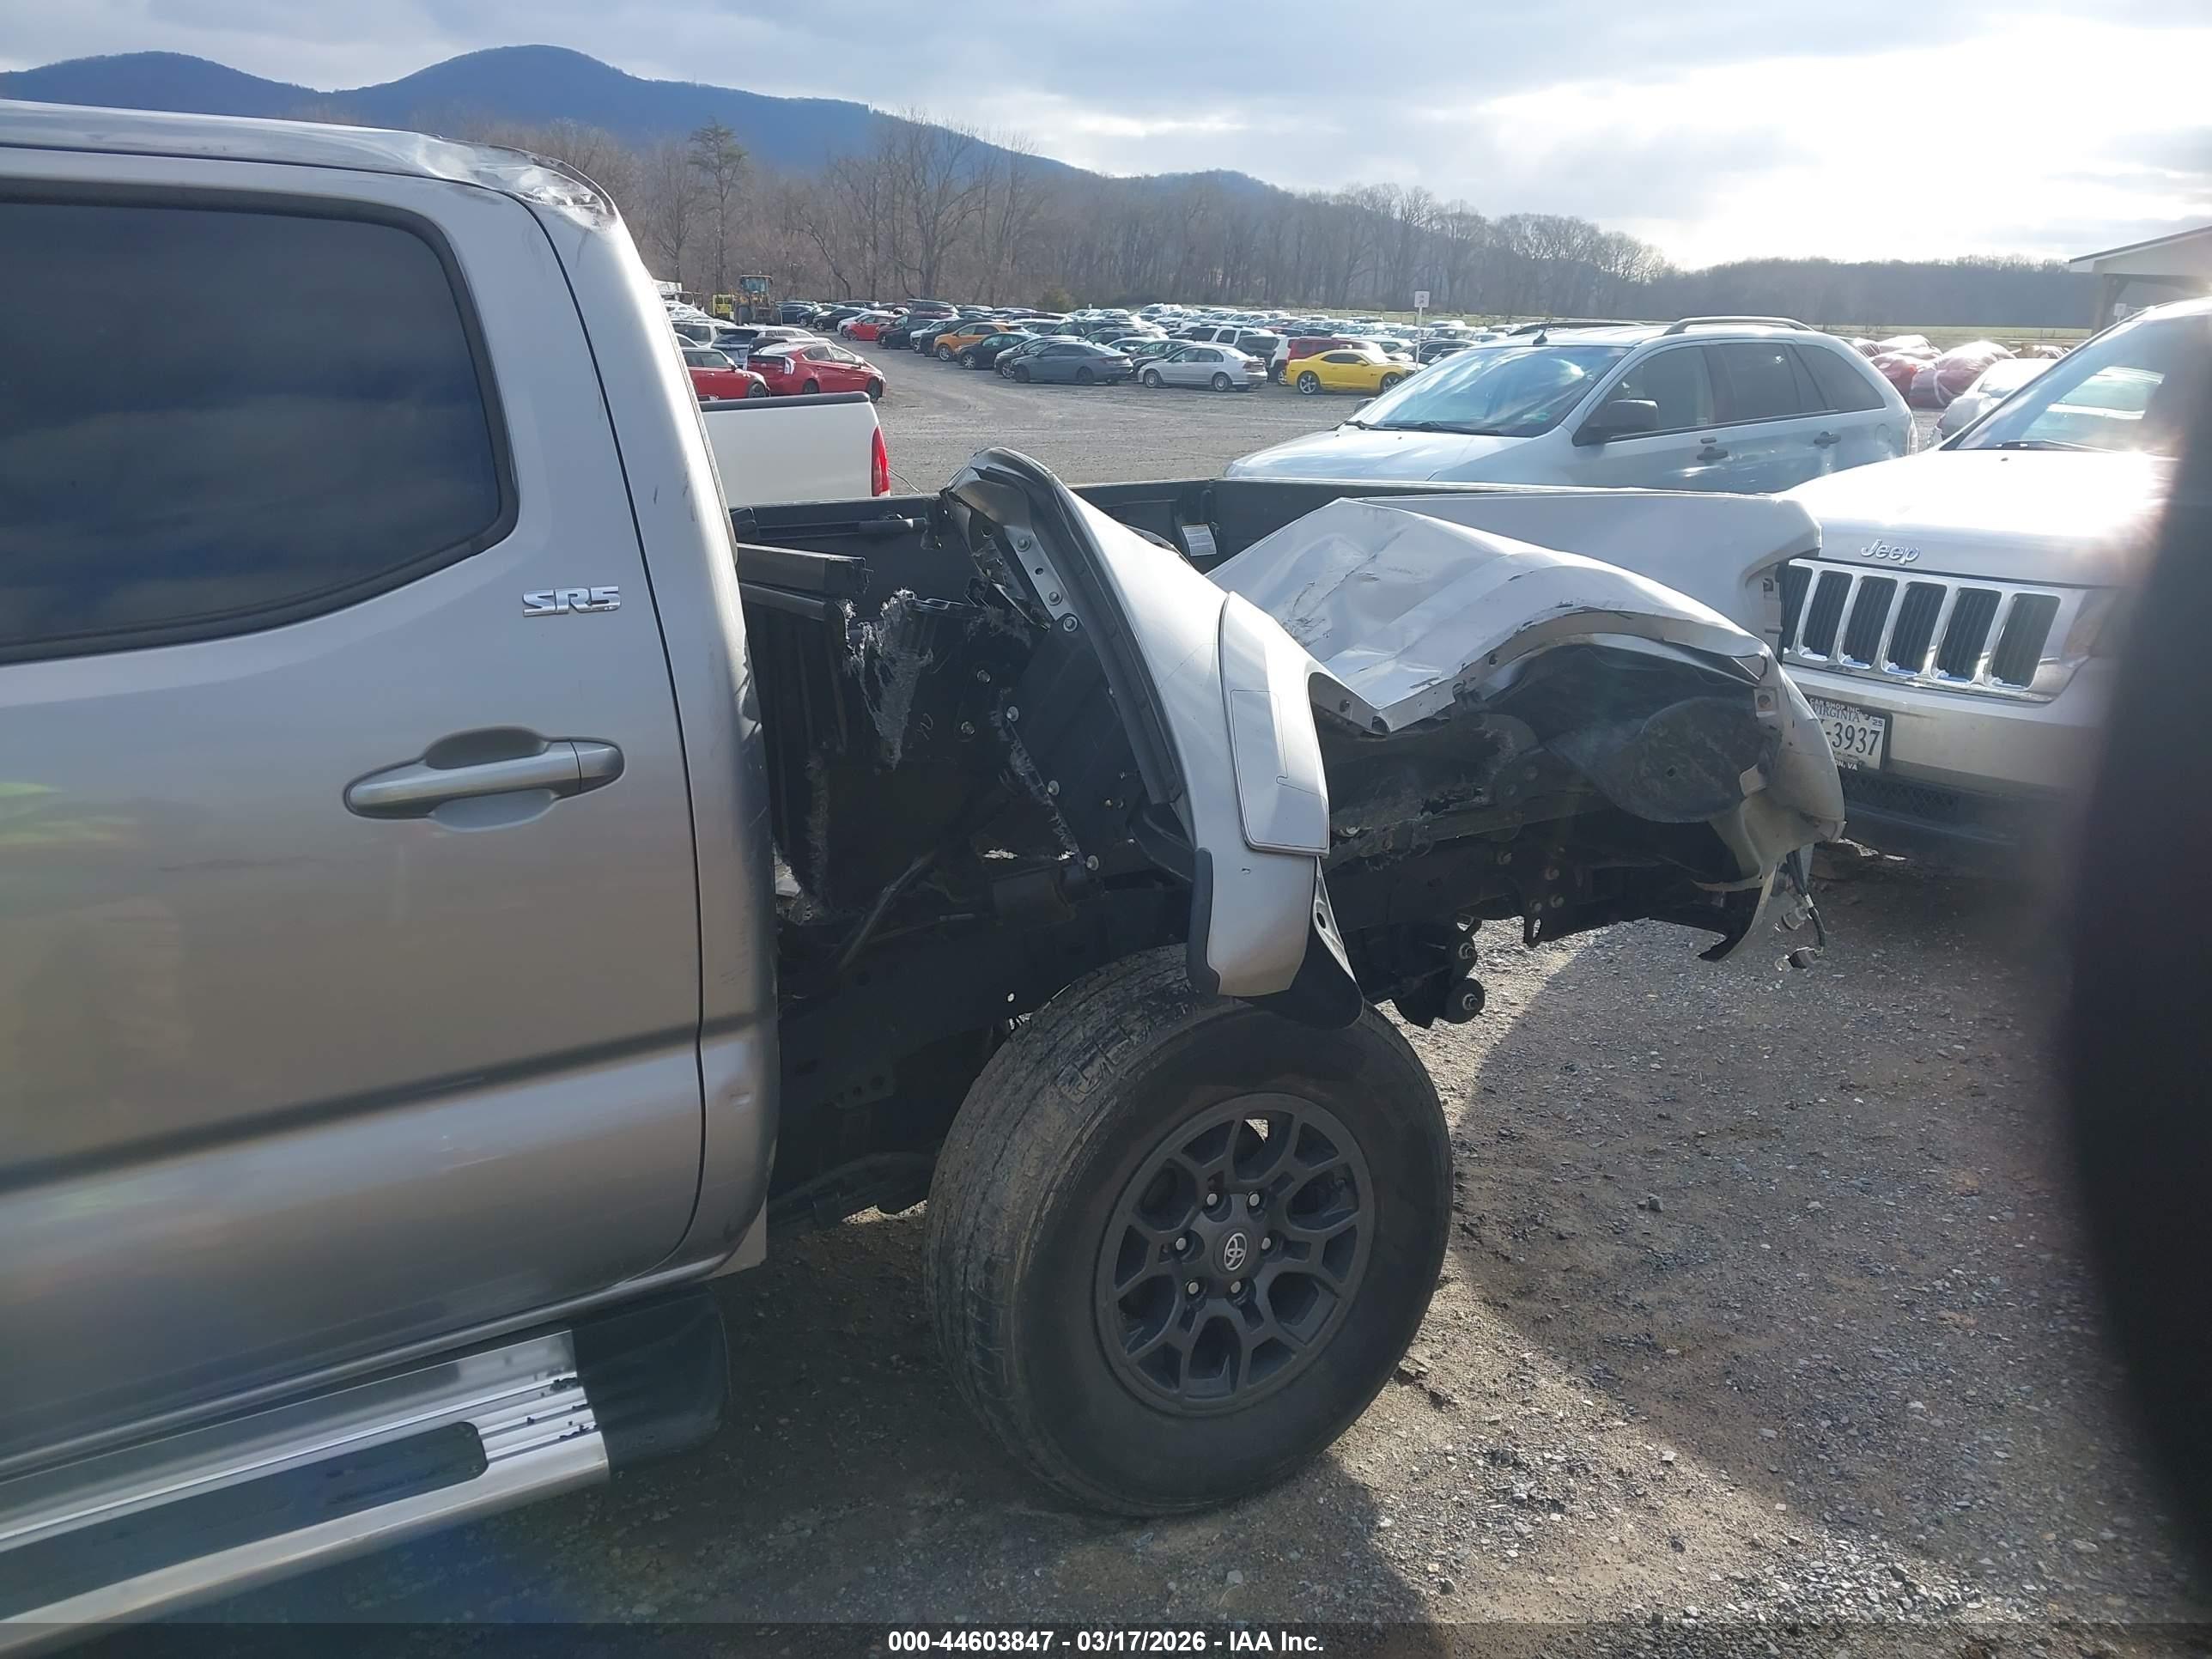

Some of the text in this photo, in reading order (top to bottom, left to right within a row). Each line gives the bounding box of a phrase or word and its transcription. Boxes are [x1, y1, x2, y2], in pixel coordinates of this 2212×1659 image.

[1861, 538, 1920, 566] Jeep
[522, 585, 622, 617] SR5
[1813, 704, 1860, 723] VIRGINIA
[1820, 720, 1881, 757] -3937
[1847, 762, 1858, 771] VA
